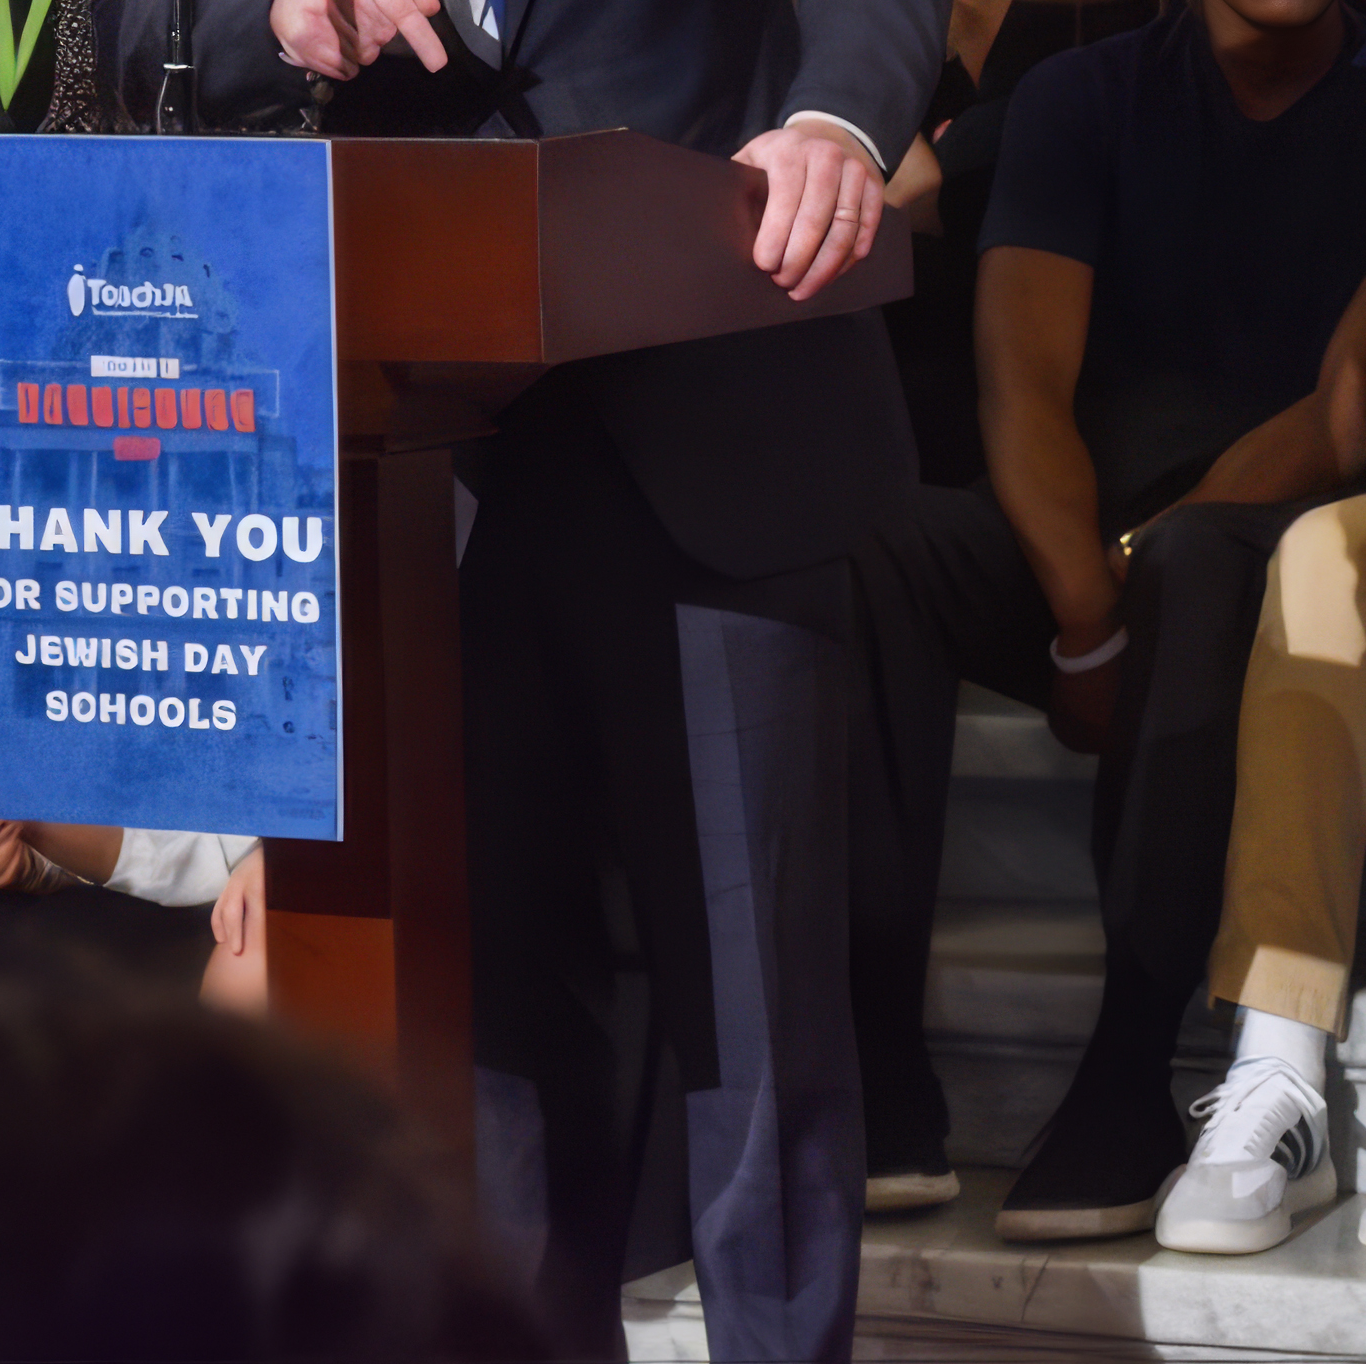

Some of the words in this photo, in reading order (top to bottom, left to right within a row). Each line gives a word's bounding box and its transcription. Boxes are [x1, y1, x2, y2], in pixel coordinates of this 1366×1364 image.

[192, 512, 324, 564] YOU
[55, 579, 320, 624] SUPPORTING
[15, 633, 169, 672] JEWISH
[184, 642, 268, 676] DAY
